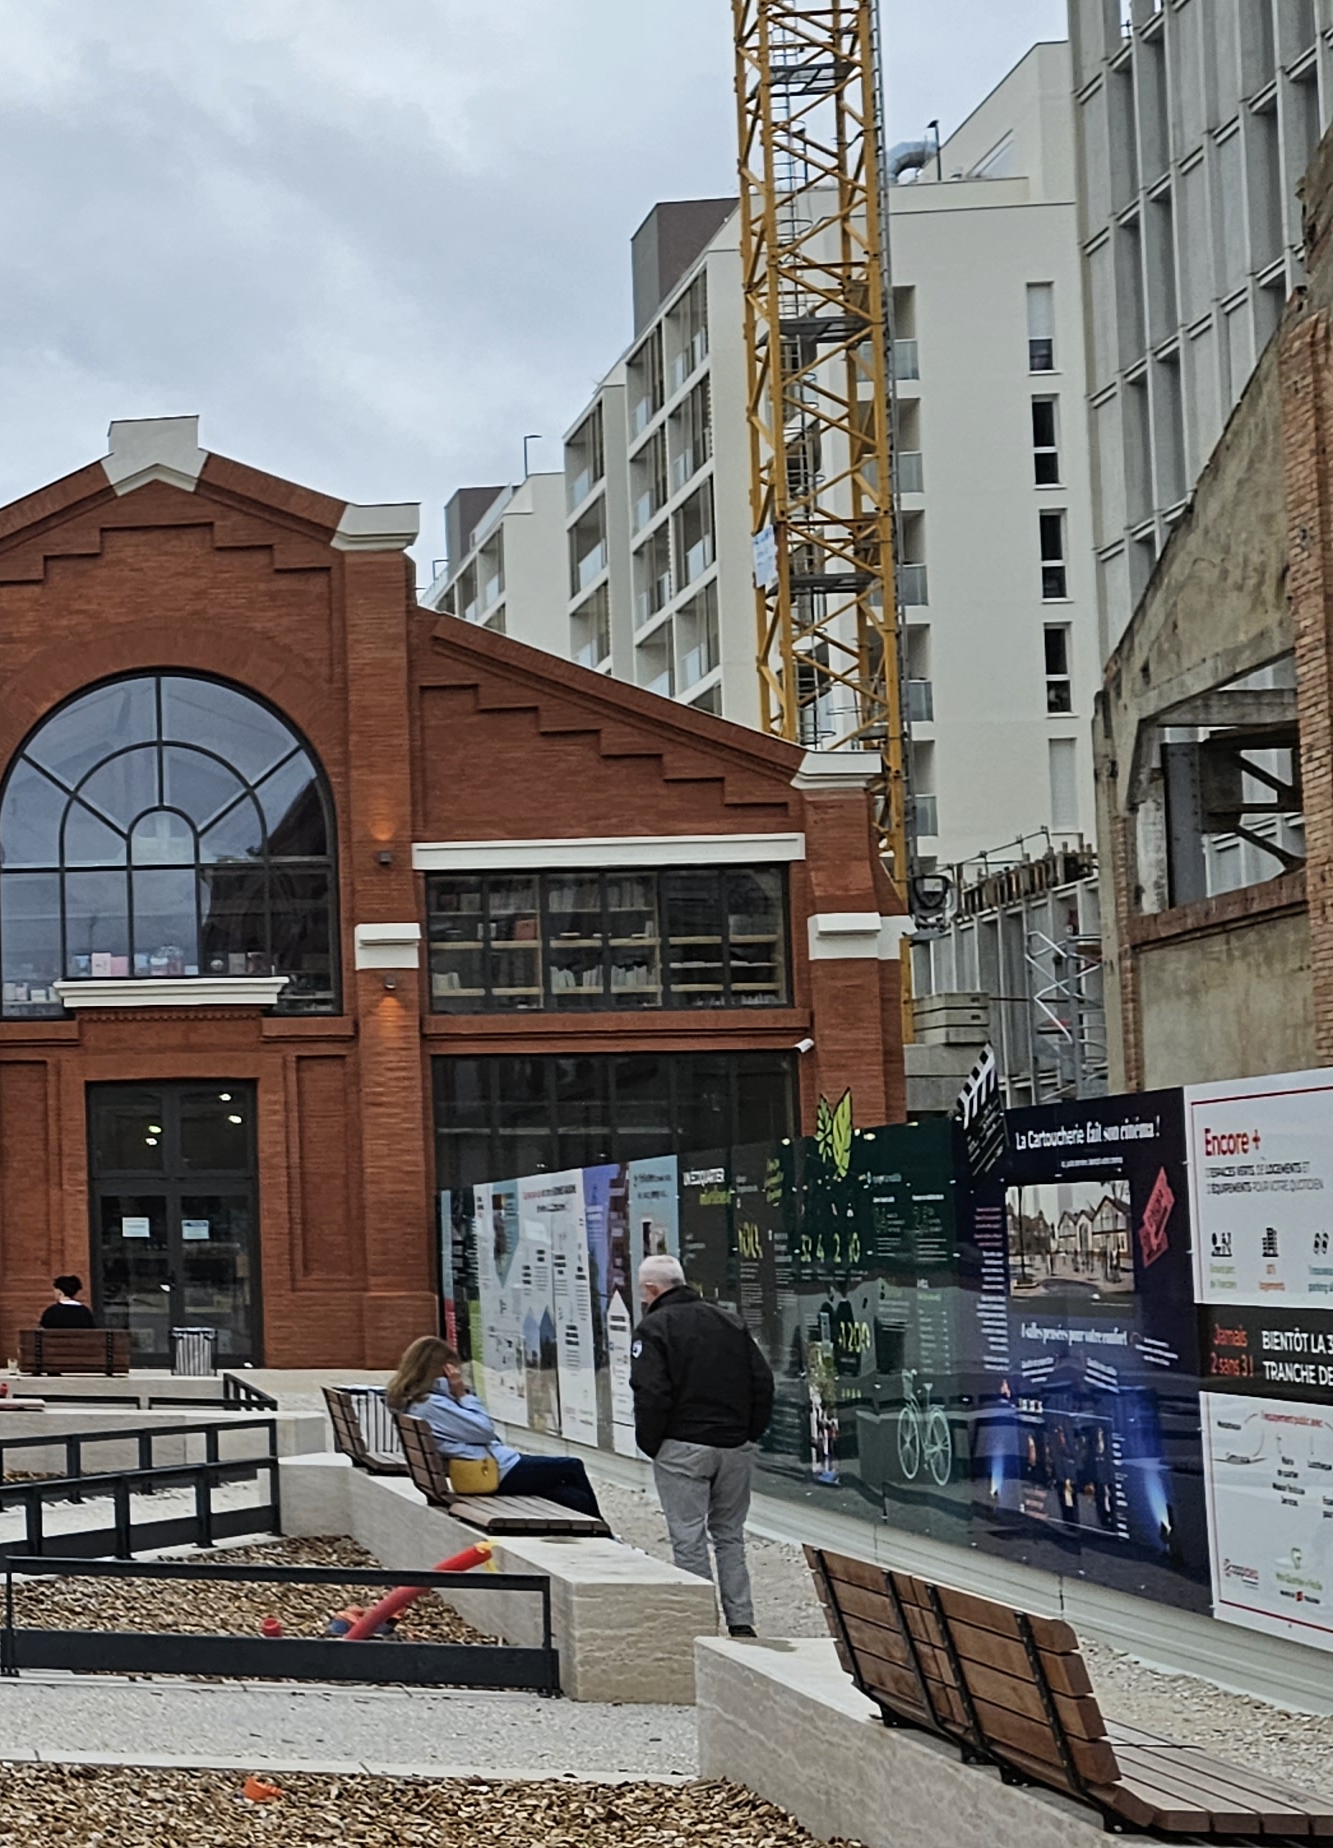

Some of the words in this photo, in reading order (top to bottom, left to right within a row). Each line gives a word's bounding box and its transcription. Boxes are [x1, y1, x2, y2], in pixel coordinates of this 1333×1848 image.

[1015, 1132, 1027, 1150] La
[1027, 1124, 1084, 1149] Cartoucherie
[1086, 1121, 1102, 1143] fait
[1120, 1116, 1154, 1140] cinéma
[1204, 1127, 1250, 1157] Encore
[1214, 1323, 1248, 1347] Jamais
[1261, 1326, 1309, 1352] BIENTÔT
[1310, 1333, 1327, 1355] LA
[1210, 1351, 1218, 1374] 2
[1219, 1358, 1240, 1376] sans
[1262, 1361, 1317, 1385] TRANCHE
